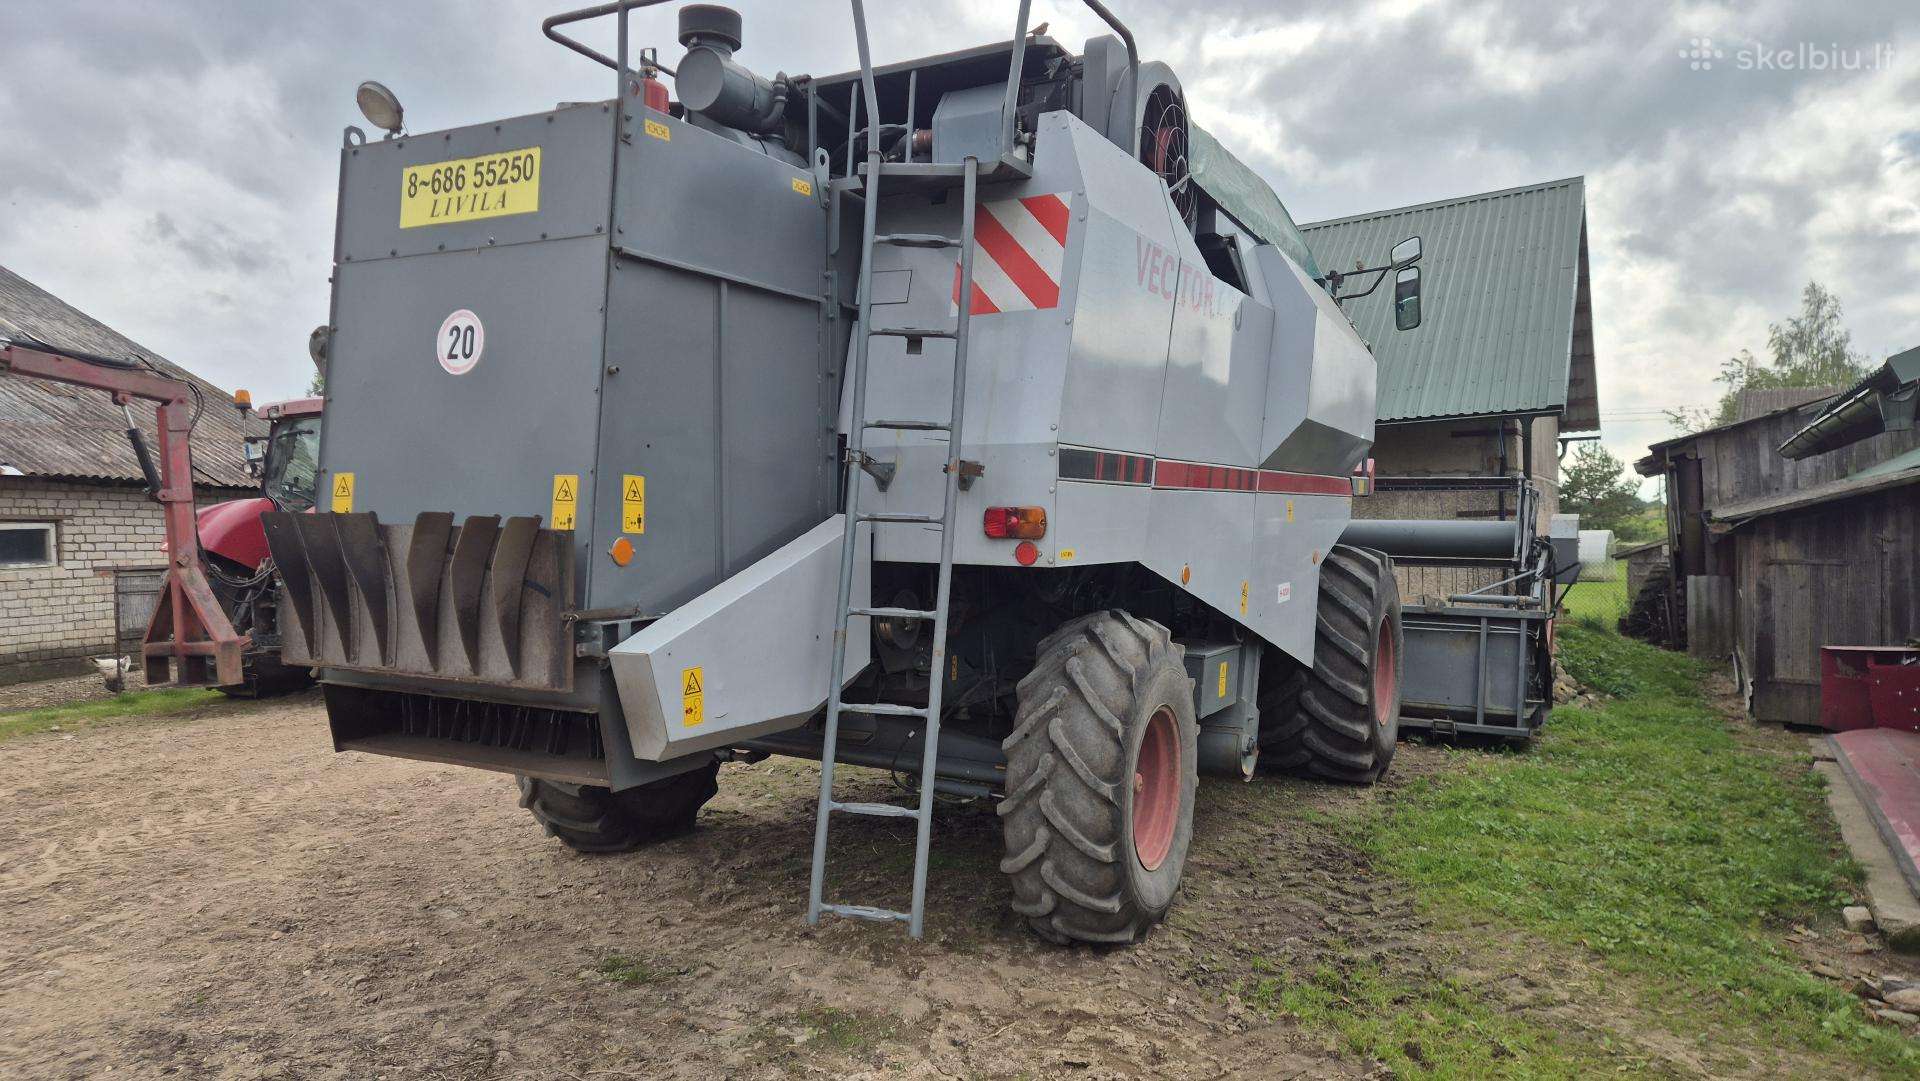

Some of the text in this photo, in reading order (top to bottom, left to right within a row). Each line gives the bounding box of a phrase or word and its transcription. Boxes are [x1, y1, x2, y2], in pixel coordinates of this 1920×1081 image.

[473, 153, 534, 189] 55250
[431, 190, 507, 218] LIVILA
[1136, 234, 1214, 319] VECTOR
[447, 325, 474, 360] 20
